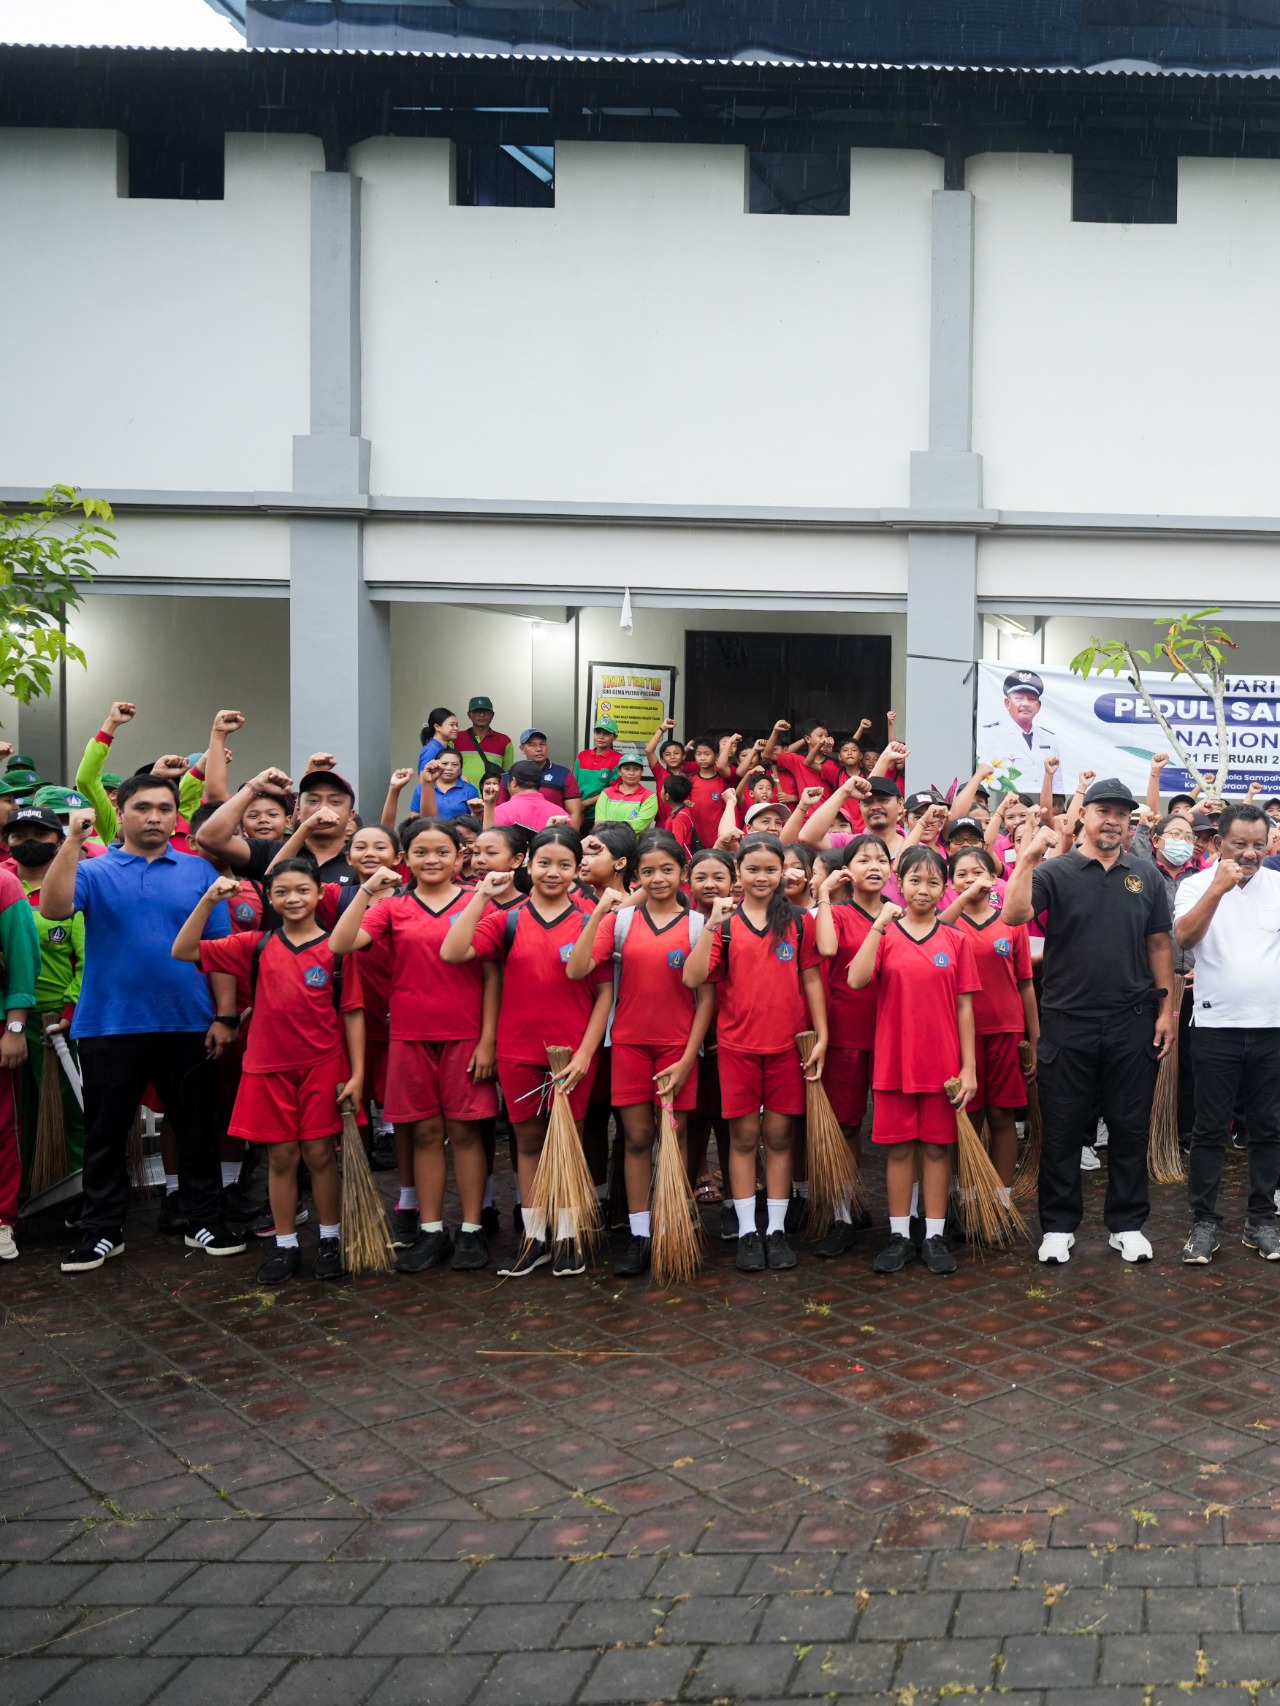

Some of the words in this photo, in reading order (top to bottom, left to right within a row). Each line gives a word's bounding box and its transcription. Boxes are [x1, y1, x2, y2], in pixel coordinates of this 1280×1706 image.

[602, 675, 625, 688] TATA
[627, 676, 661, 691] TERTIB
[1204, 753, 1268, 765] FERUARI
[1244, 774, 1280, 783] Sampah
